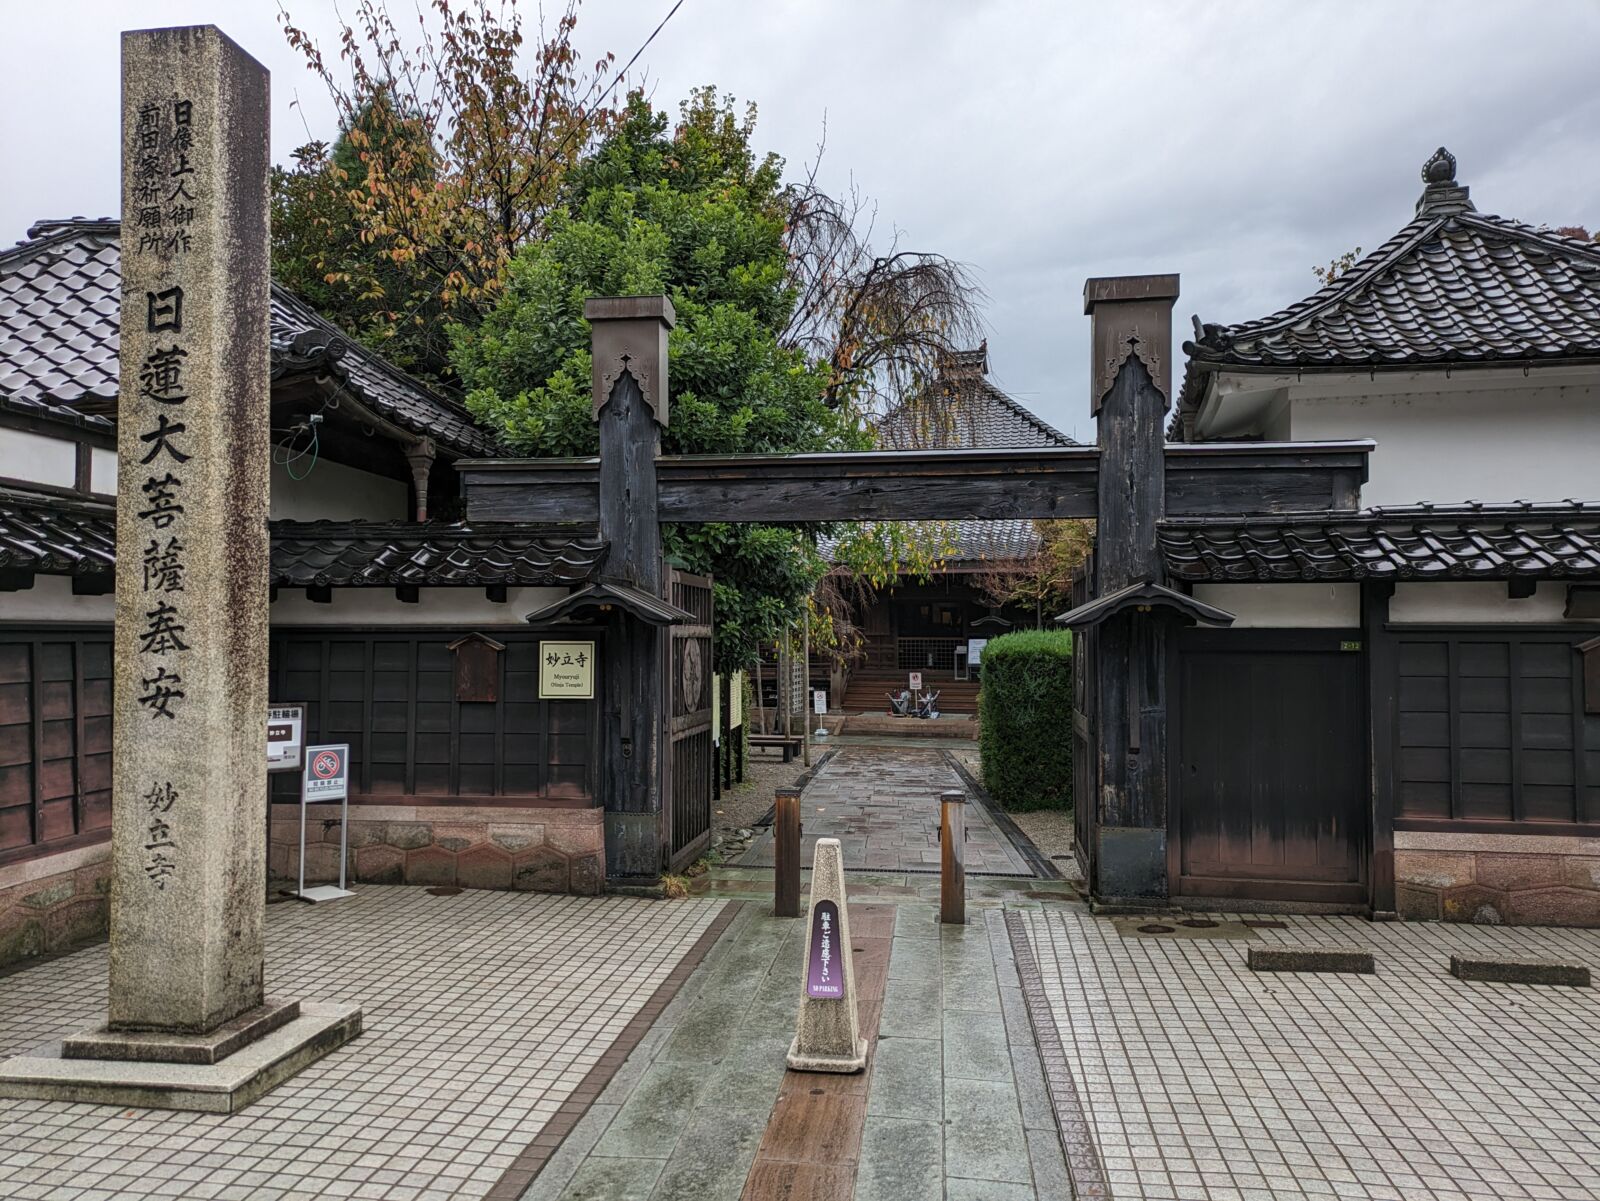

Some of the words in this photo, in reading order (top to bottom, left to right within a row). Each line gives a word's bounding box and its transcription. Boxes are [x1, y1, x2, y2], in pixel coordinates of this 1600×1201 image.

[138, 284, 192, 720] 日蓮大菩薩奉安
[546, 651, 588, 668] 妙立寺
[142, 780, 180, 891] 妙立寺
